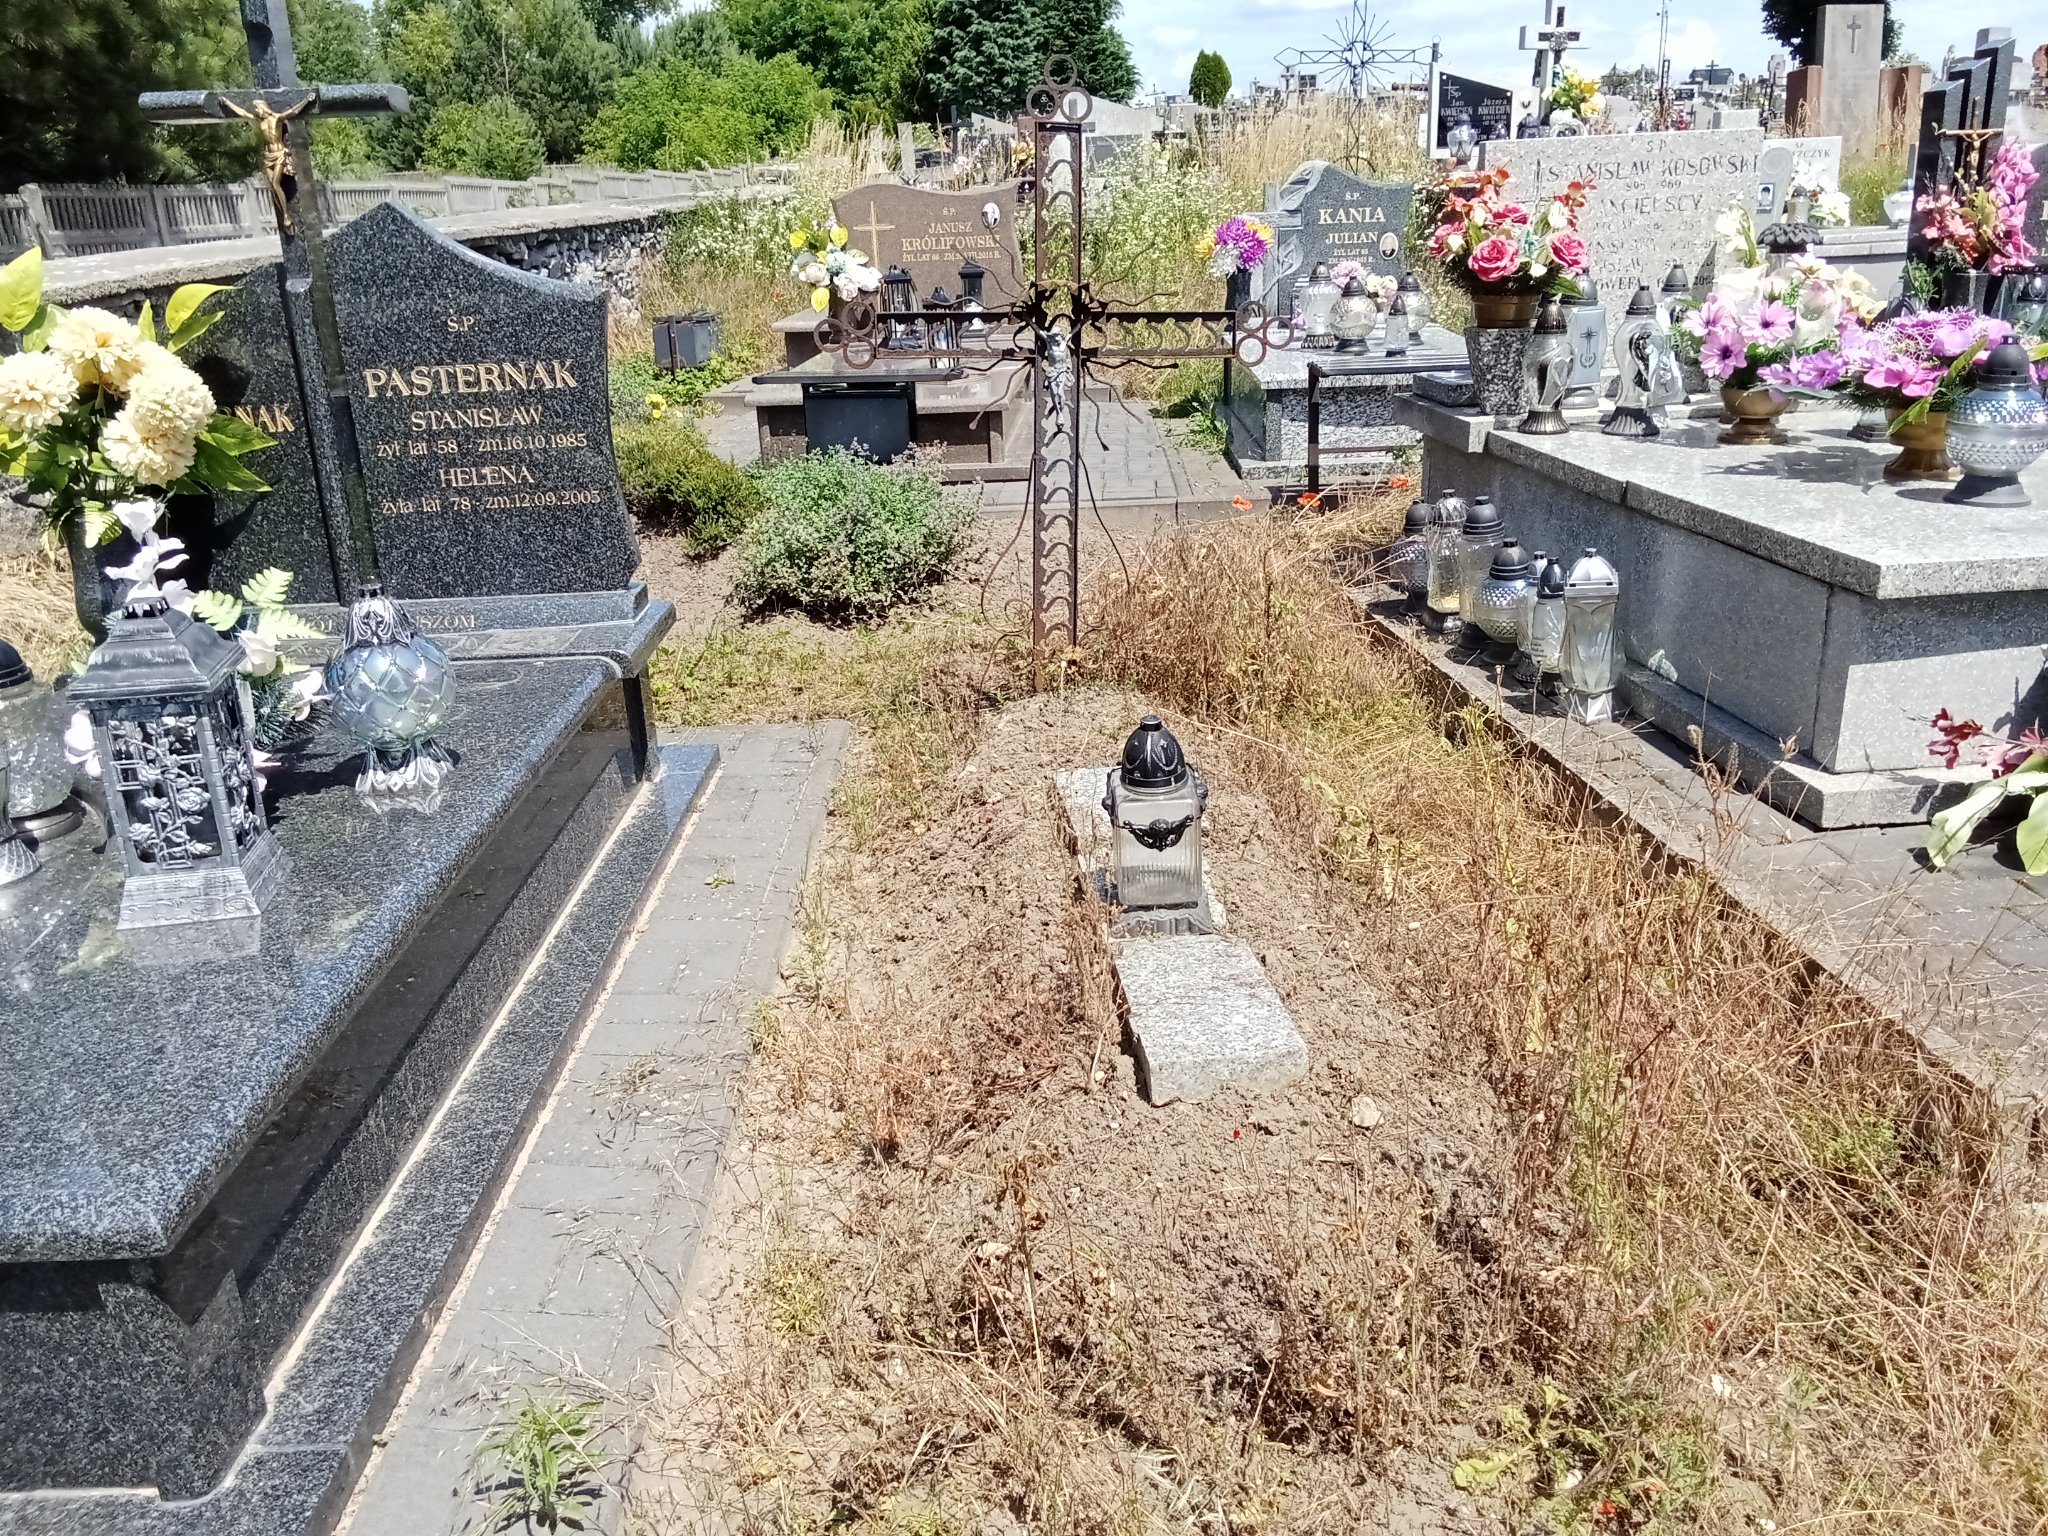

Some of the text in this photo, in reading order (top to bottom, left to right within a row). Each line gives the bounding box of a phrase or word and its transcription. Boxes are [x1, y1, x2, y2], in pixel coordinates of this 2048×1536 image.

[1318, 206, 1386, 225] KANIA
[928, 221, 973, 234] JANUSZ
[901, 235, 1001, 251] KRÓLIKOWSKI
[1325, 232, 1379, 245] JULIAN
[917, 252, 931, 261] LAT
[363, 359, 578, 398] PASTERNAK
[411, 405, 542, 431] STANISŁAW
[409, 440, 428, 456] lat
[437, 440, 459, 454] 58
[439, 465, 535, 487] HELENA
[423, 497, 442, 513] lat
[452, 496, 472, 511] 78
